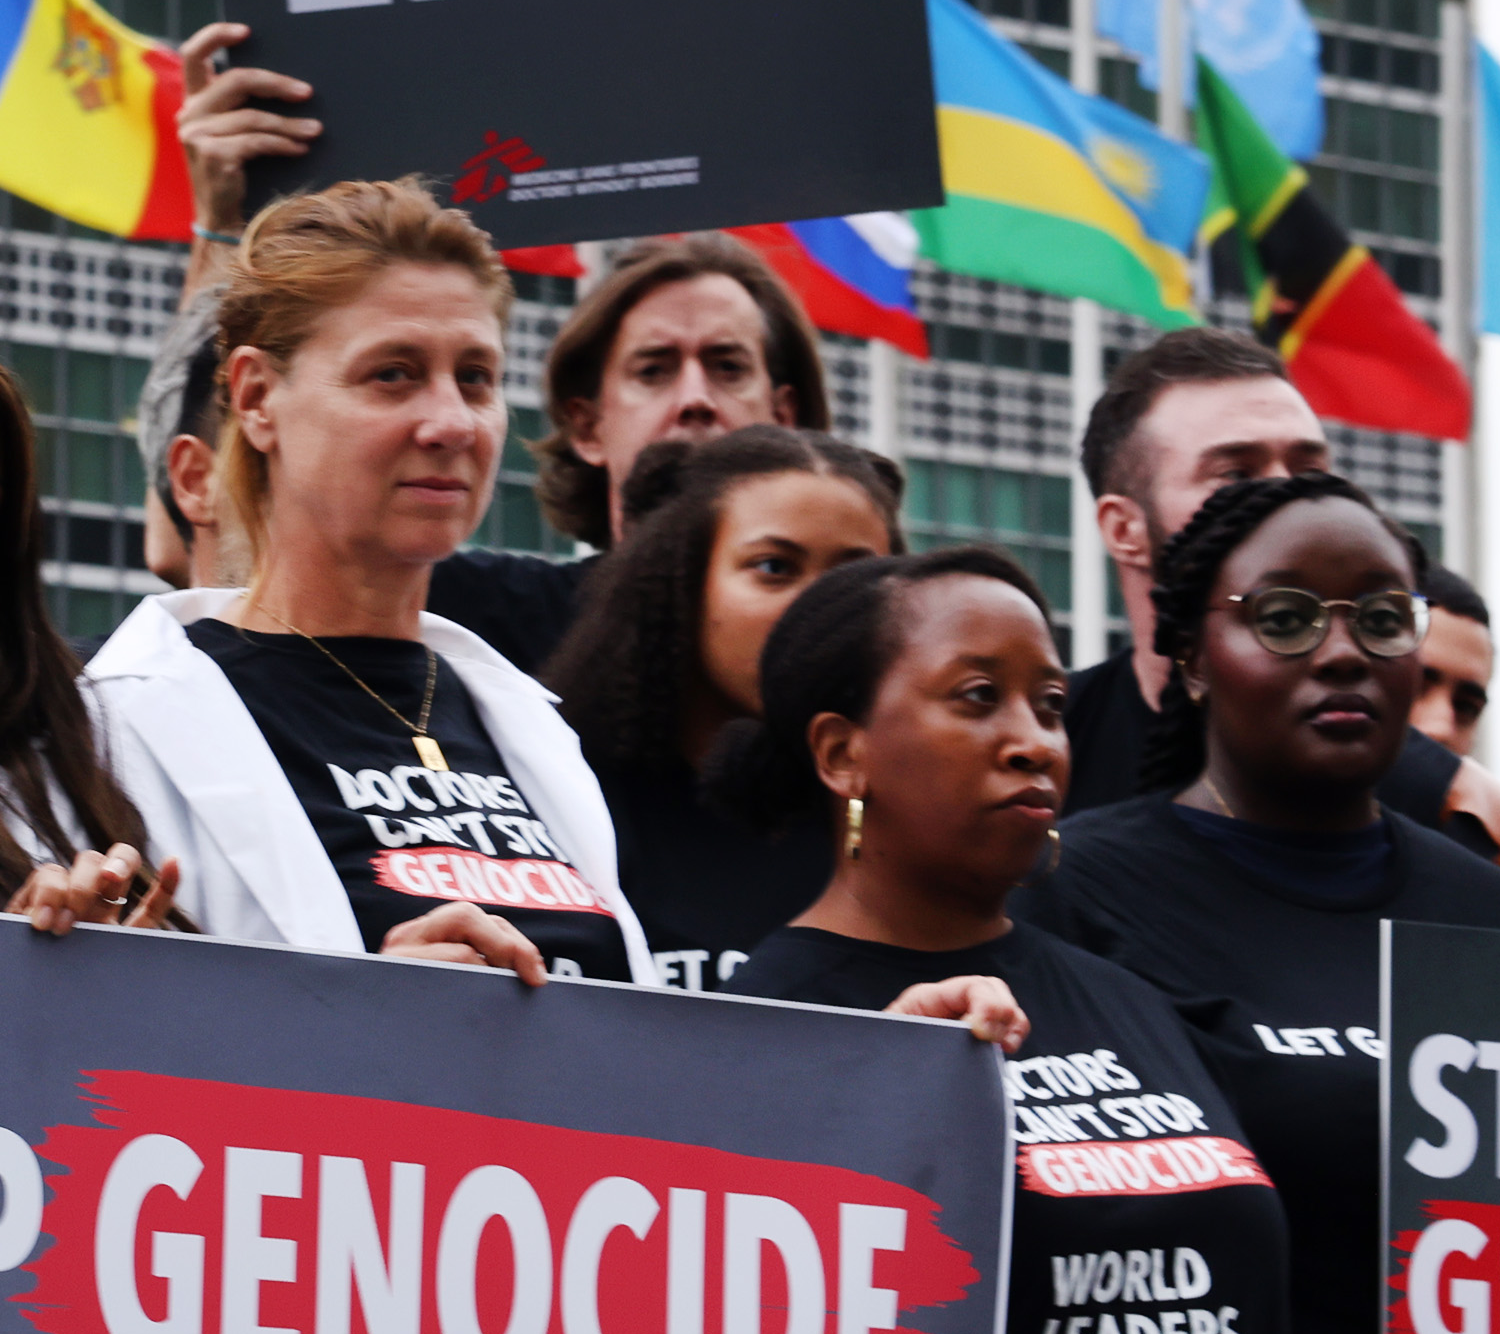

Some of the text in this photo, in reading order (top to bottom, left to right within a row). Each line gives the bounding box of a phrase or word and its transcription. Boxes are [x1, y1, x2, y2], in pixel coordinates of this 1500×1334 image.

[326, 763, 530, 814] DOCTORS
[488, 813, 570, 864] STO
[388, 853, 608, 907] GENOCID
[1252, 1023, 1346, 1057] LET
[1004, 1050, 1141, 1100] CTORS
[1099, 1092, 1209, 1138] STOP
[1030, 1137, 1255, 1194] GENOCIDE.
[1051, 1247, 1212, 1307] WORLD
